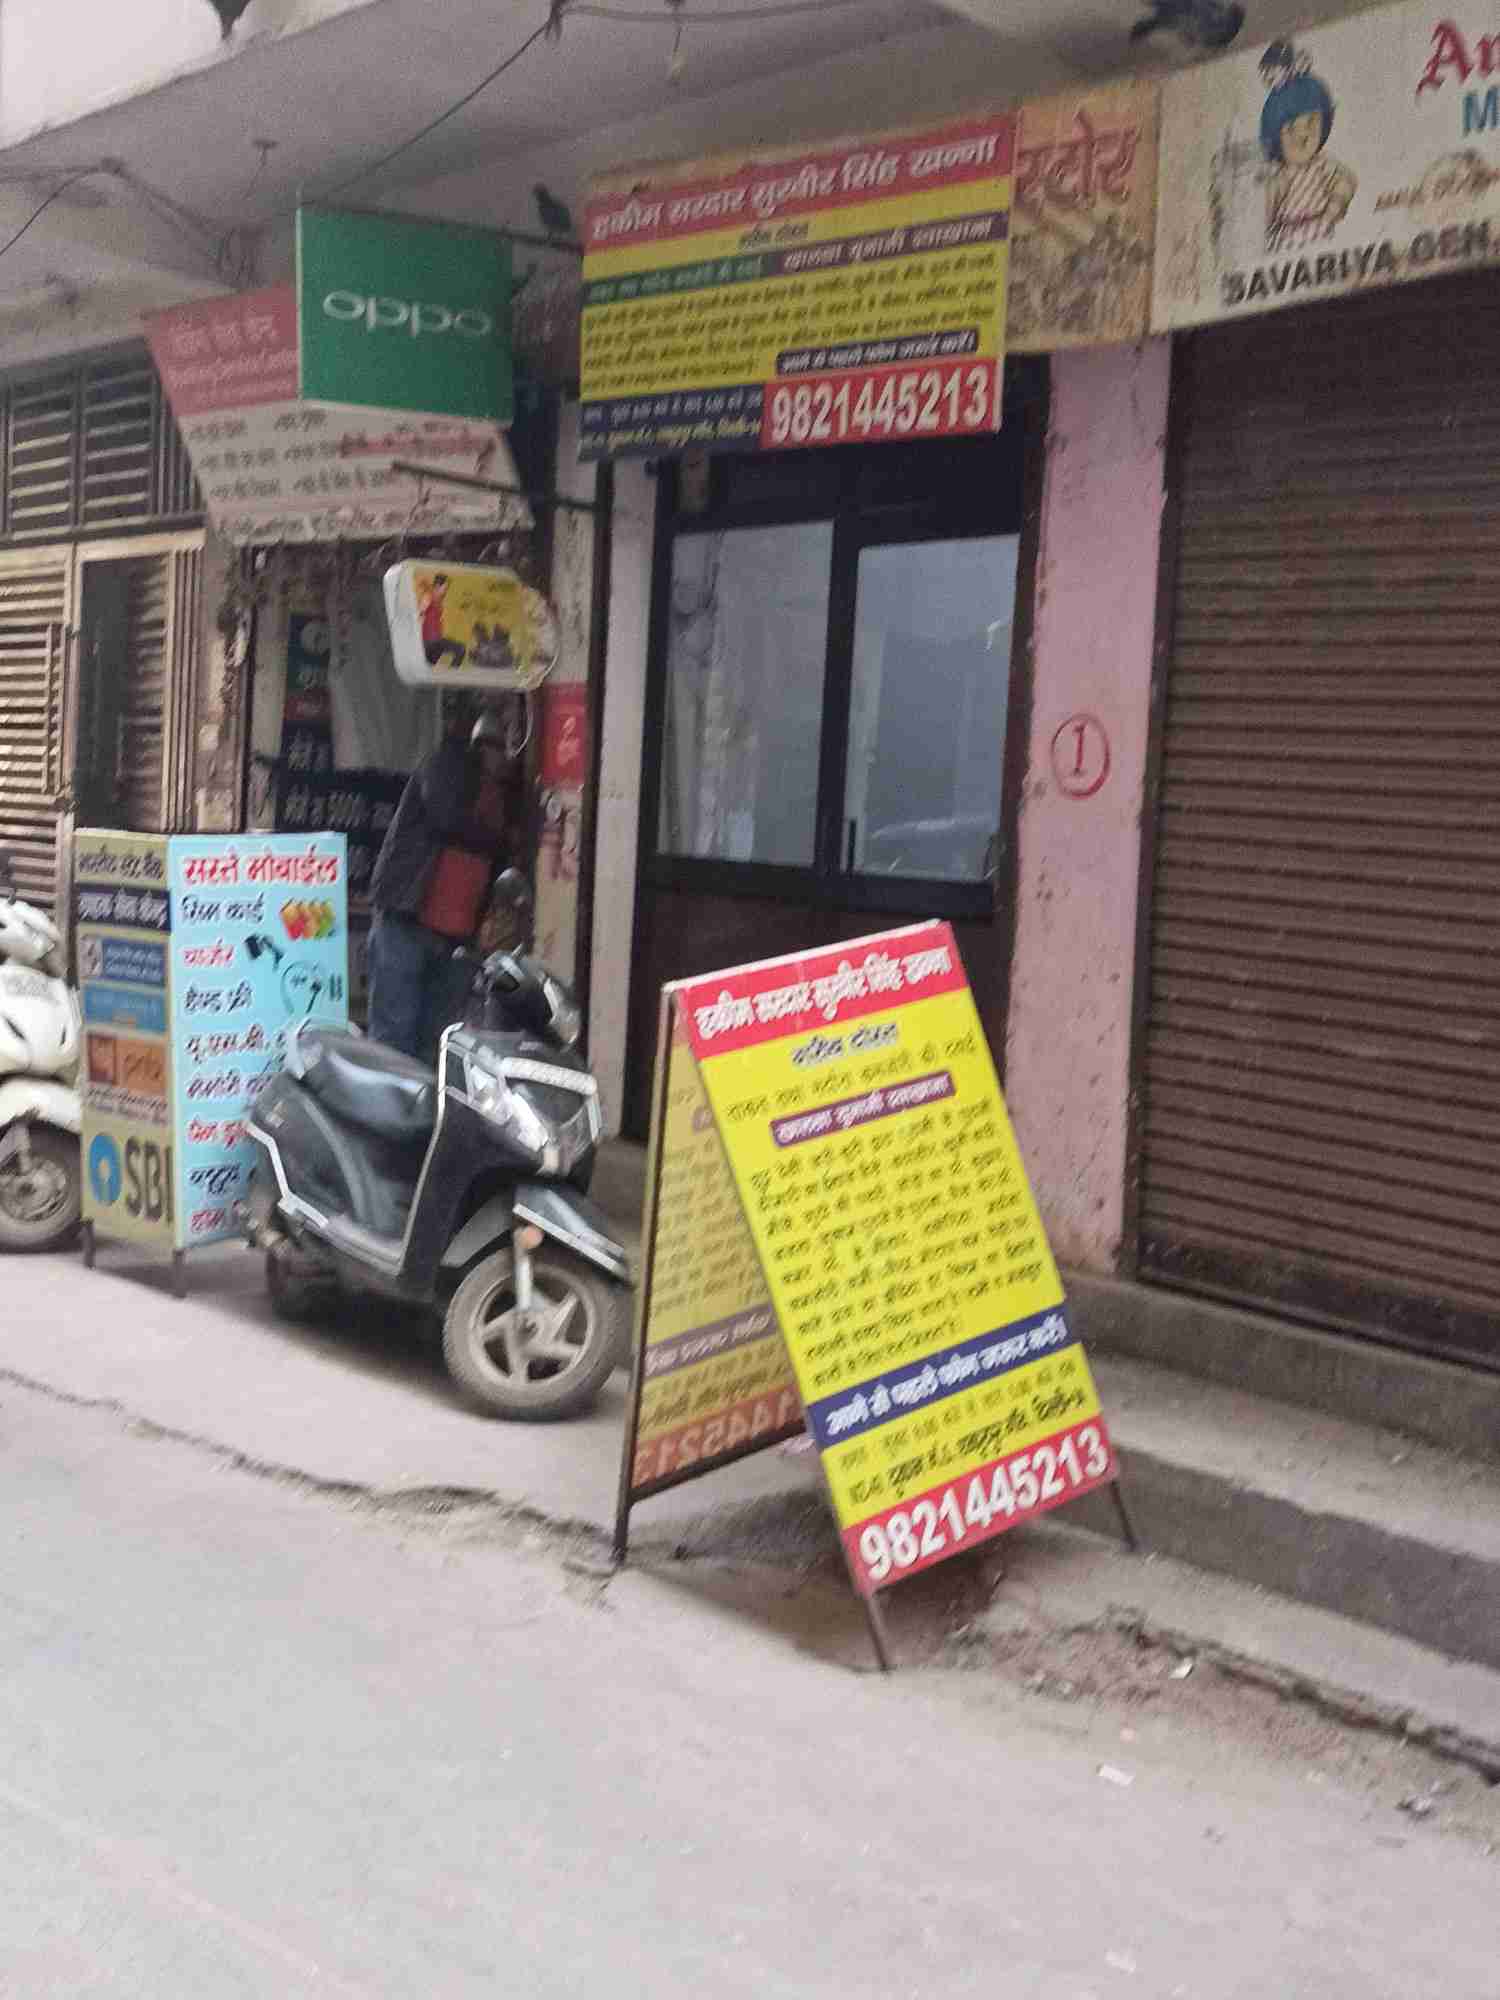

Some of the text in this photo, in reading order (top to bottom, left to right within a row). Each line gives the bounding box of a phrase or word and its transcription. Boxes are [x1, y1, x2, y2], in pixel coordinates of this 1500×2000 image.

[770, 365, 990, 445] 9821445213
[183, 848, 240, 885] सस्ते
[122, 1135, 173, 1225] SBI
[859, 1426, 1110, 1580] 9821445213
